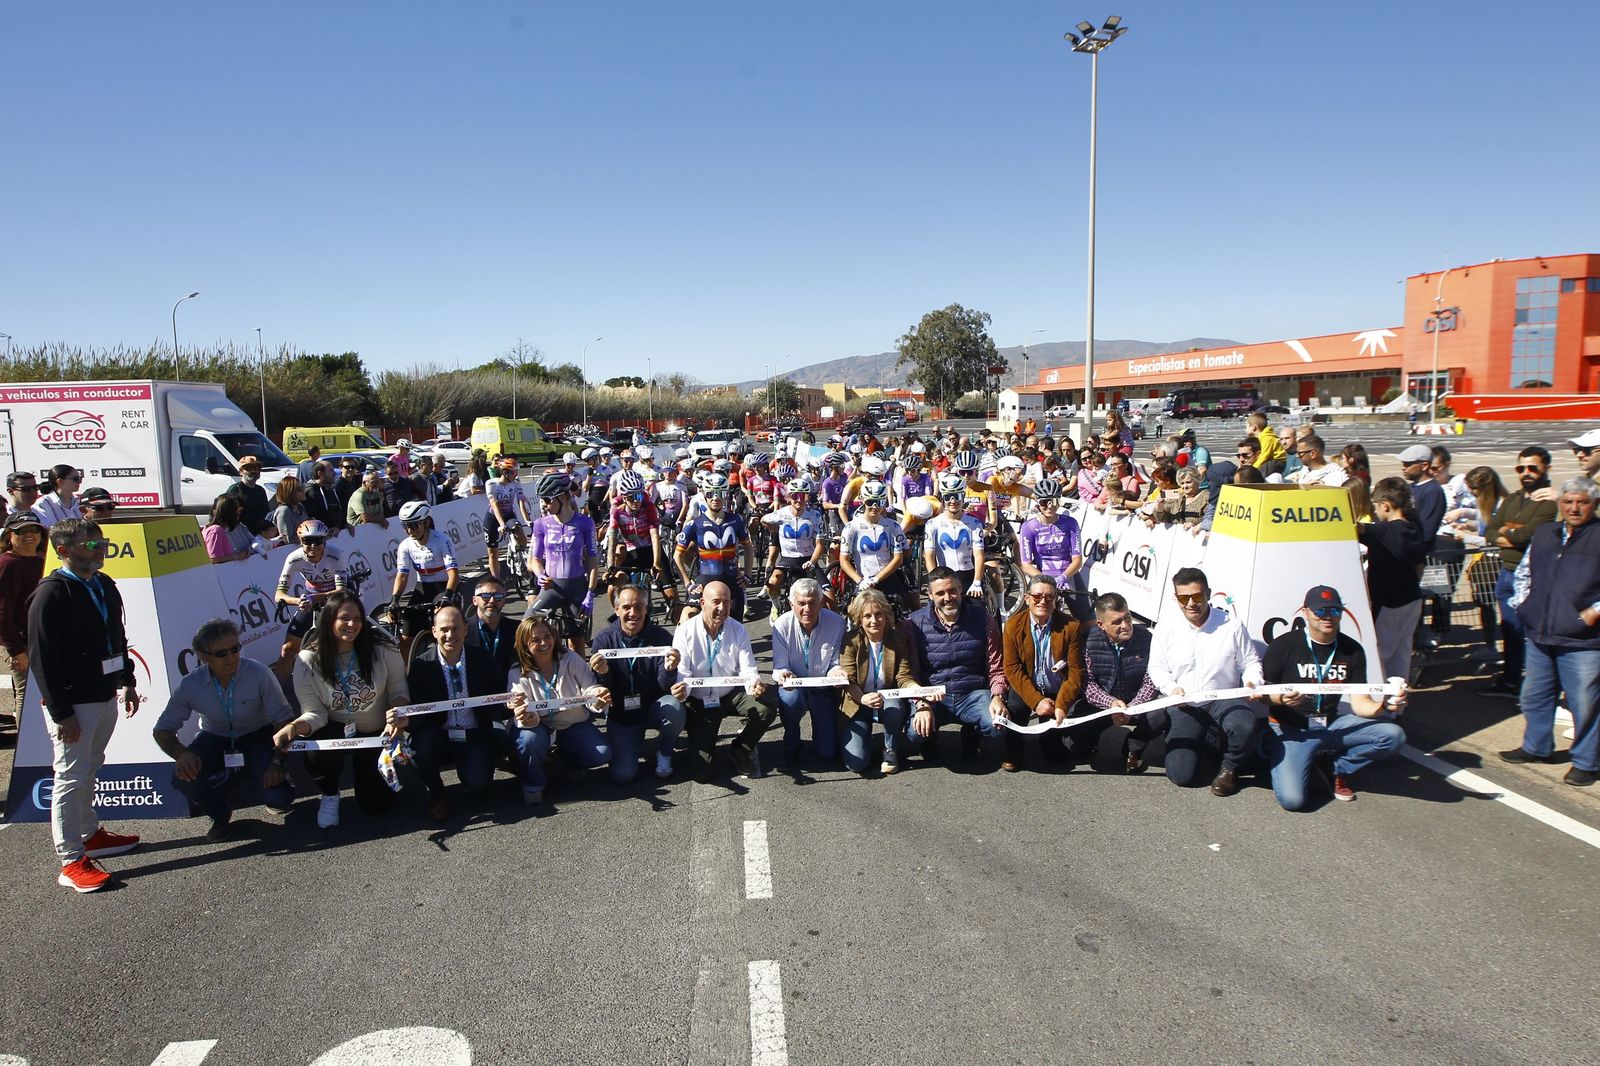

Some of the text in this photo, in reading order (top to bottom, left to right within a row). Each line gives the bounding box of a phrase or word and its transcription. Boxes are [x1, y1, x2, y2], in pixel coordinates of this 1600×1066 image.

[1128, 351, 1244, 376] Especialistas en tomate
[6, 387, 144, 400] vehículos sin conductor
[121, 410, 146, 418] RENT
[121, 420, 149, 429] A CAR
[37, 425, 107, 442] Cerezo
[290, 440, 304, 448] 24
[111, 493, 154, 503] iler.com
[1218, 501, 1252, 522] SALIDA
[1271, 506, 1343, 524] SALIDA
[155, 532, 203, 556] SALIDA
[1122, 551, 1152, 580] CASI
[116, 693, 148, 704] Tote
[94, 775, 153, 791] Smurfit
[91, 791, 163, 807] Westrock
